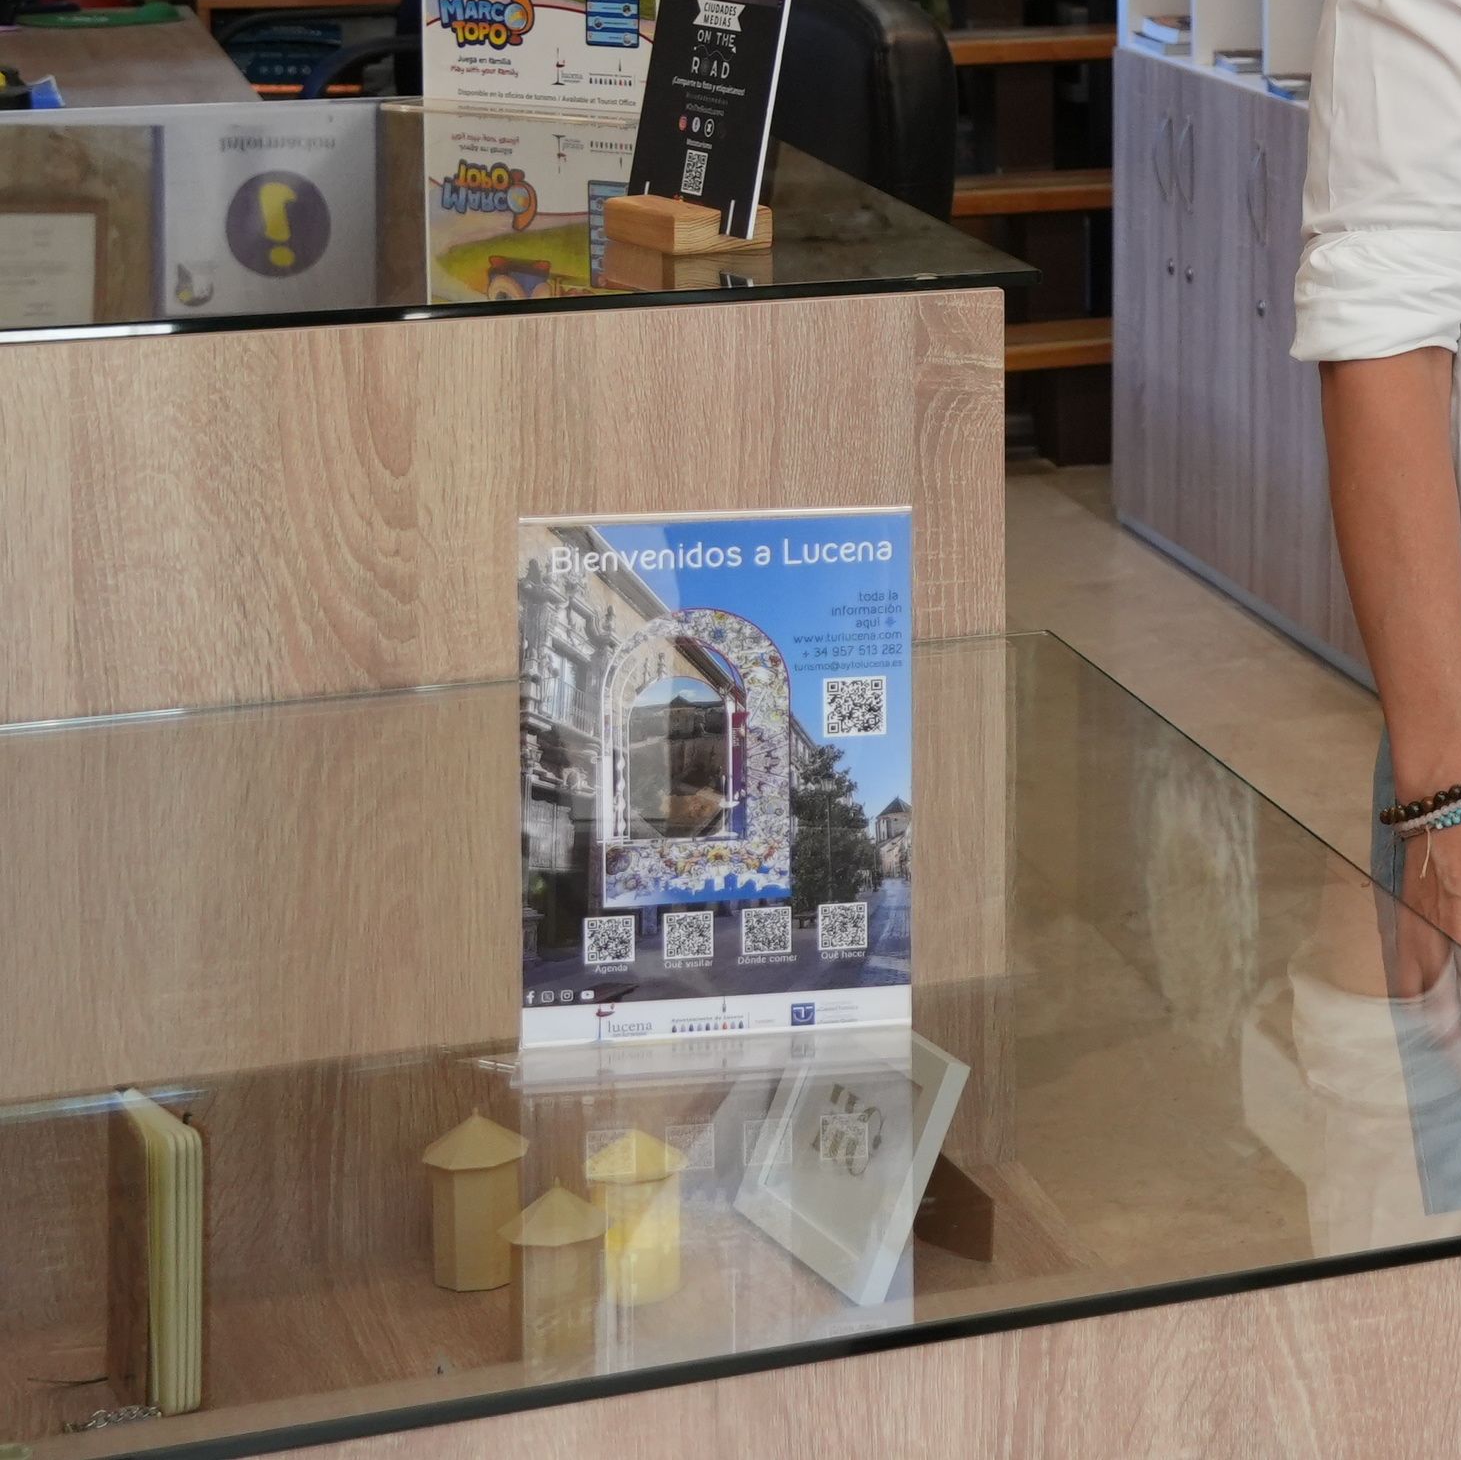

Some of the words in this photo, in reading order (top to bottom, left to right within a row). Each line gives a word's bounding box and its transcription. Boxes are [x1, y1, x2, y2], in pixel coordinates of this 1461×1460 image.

[703, 1, 737, 16] CIUDADES
[703, 14, 732, 28] MEDIAS
[452, 19, 510, 51] TOPO
[697, 29, 712, 45] ON
[716, 31, 736, 48] THE
[551, 542, 742, 575] Bienvenidos
[754, 544, 772, 567] a
[784, 538, 893, 565] Lucena
[858, 590, 885, 602] toda
[888, 589, 899, 602] la
[831, 604, 902, 617] información
[814, 647, 828, 658] 34
[832, 645, 854, 657] 957
[737, 953, 765, 965] Dónde
[767, 954, 798, 963] comer
[820, 949, 840, 960] Qué
[841, 949, 867, 959] hacer
[595, 964, 628, 975] Agenda
[664, 958, 684, 969] Qué
[608, 1020, 653, 1033] lucena
